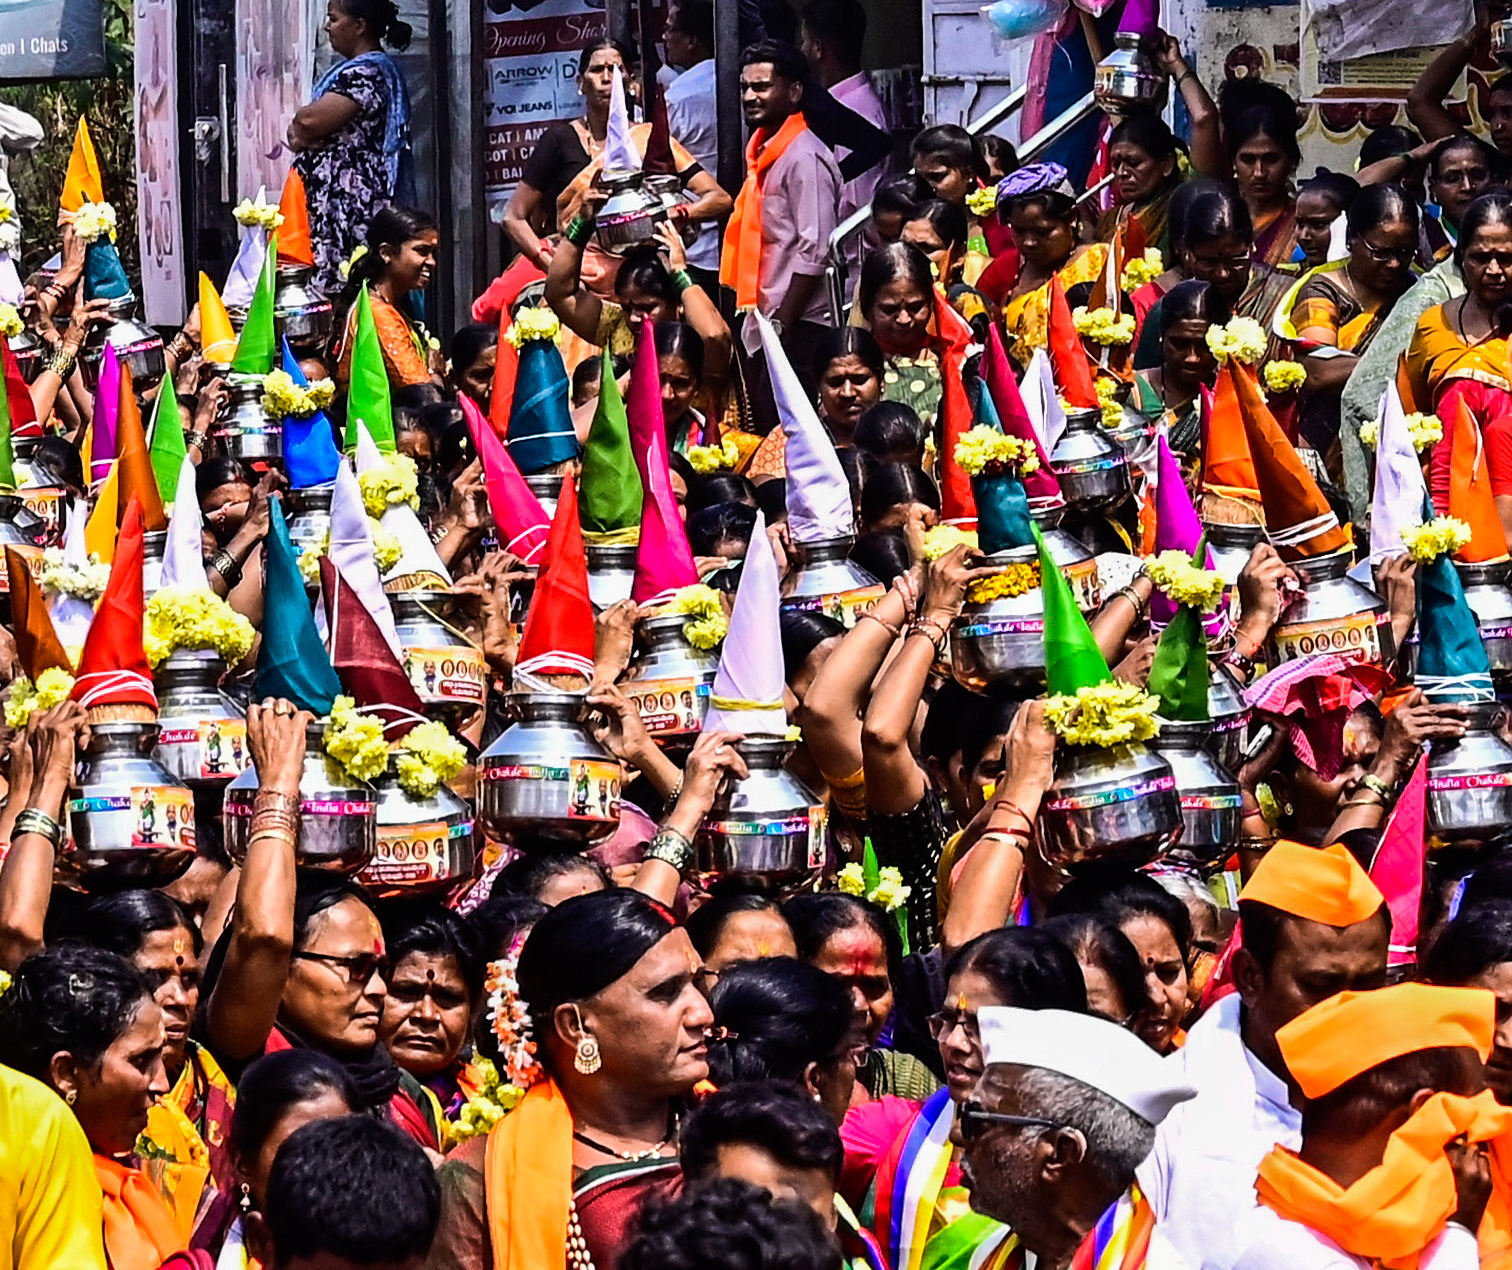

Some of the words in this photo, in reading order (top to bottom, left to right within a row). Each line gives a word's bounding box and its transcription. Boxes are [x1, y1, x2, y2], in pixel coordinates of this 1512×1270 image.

[30, 36, 69, 55] Chats
[494, 65, 553, 80] ARROW
[518, 100, 553, 114] JEANS
[489, 131, 512, 144] CAT
